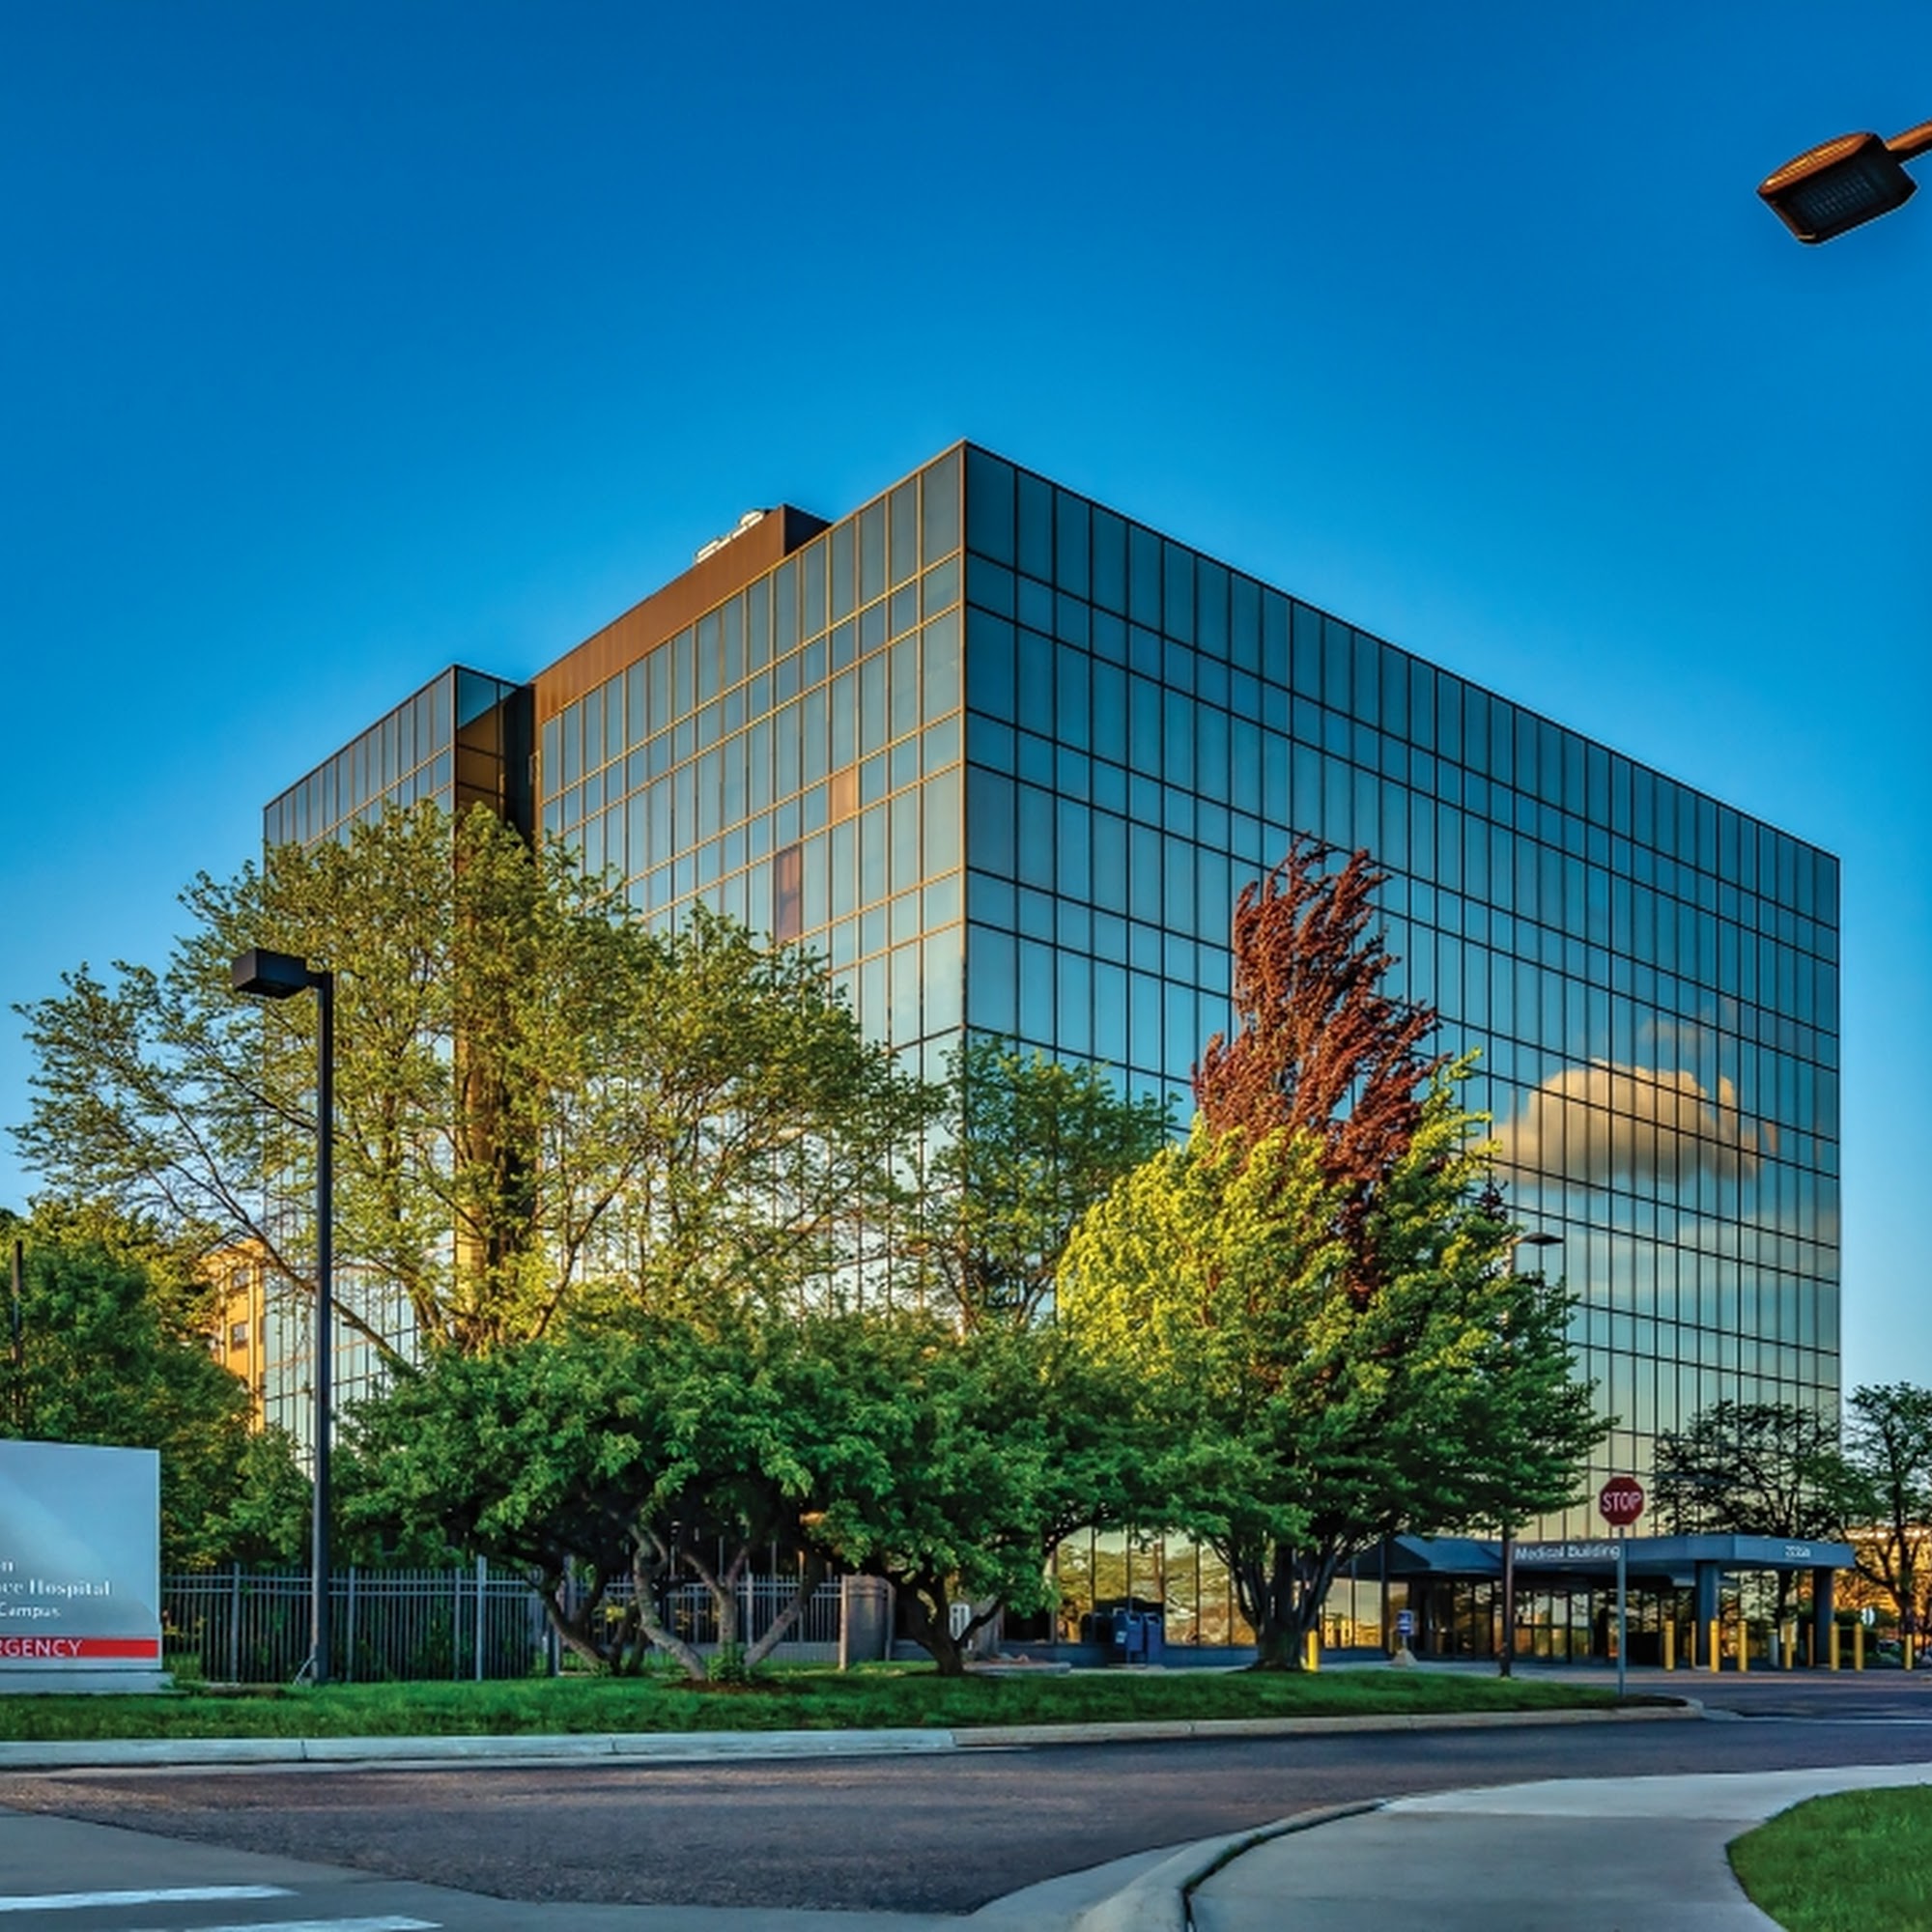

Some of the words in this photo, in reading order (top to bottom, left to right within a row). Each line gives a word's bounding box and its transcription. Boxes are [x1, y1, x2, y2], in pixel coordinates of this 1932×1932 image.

[1603, 1492, 1641, 1512] STOP
[1514, 1546, 1564, 1560] Medical
[1567, 1544, 1621, 1560] Building
[29, 1578, 110, 1599] Hospital
[0, 1602, 61, 1619] Campus
[0, 1638, 83, 1657] GENCY
